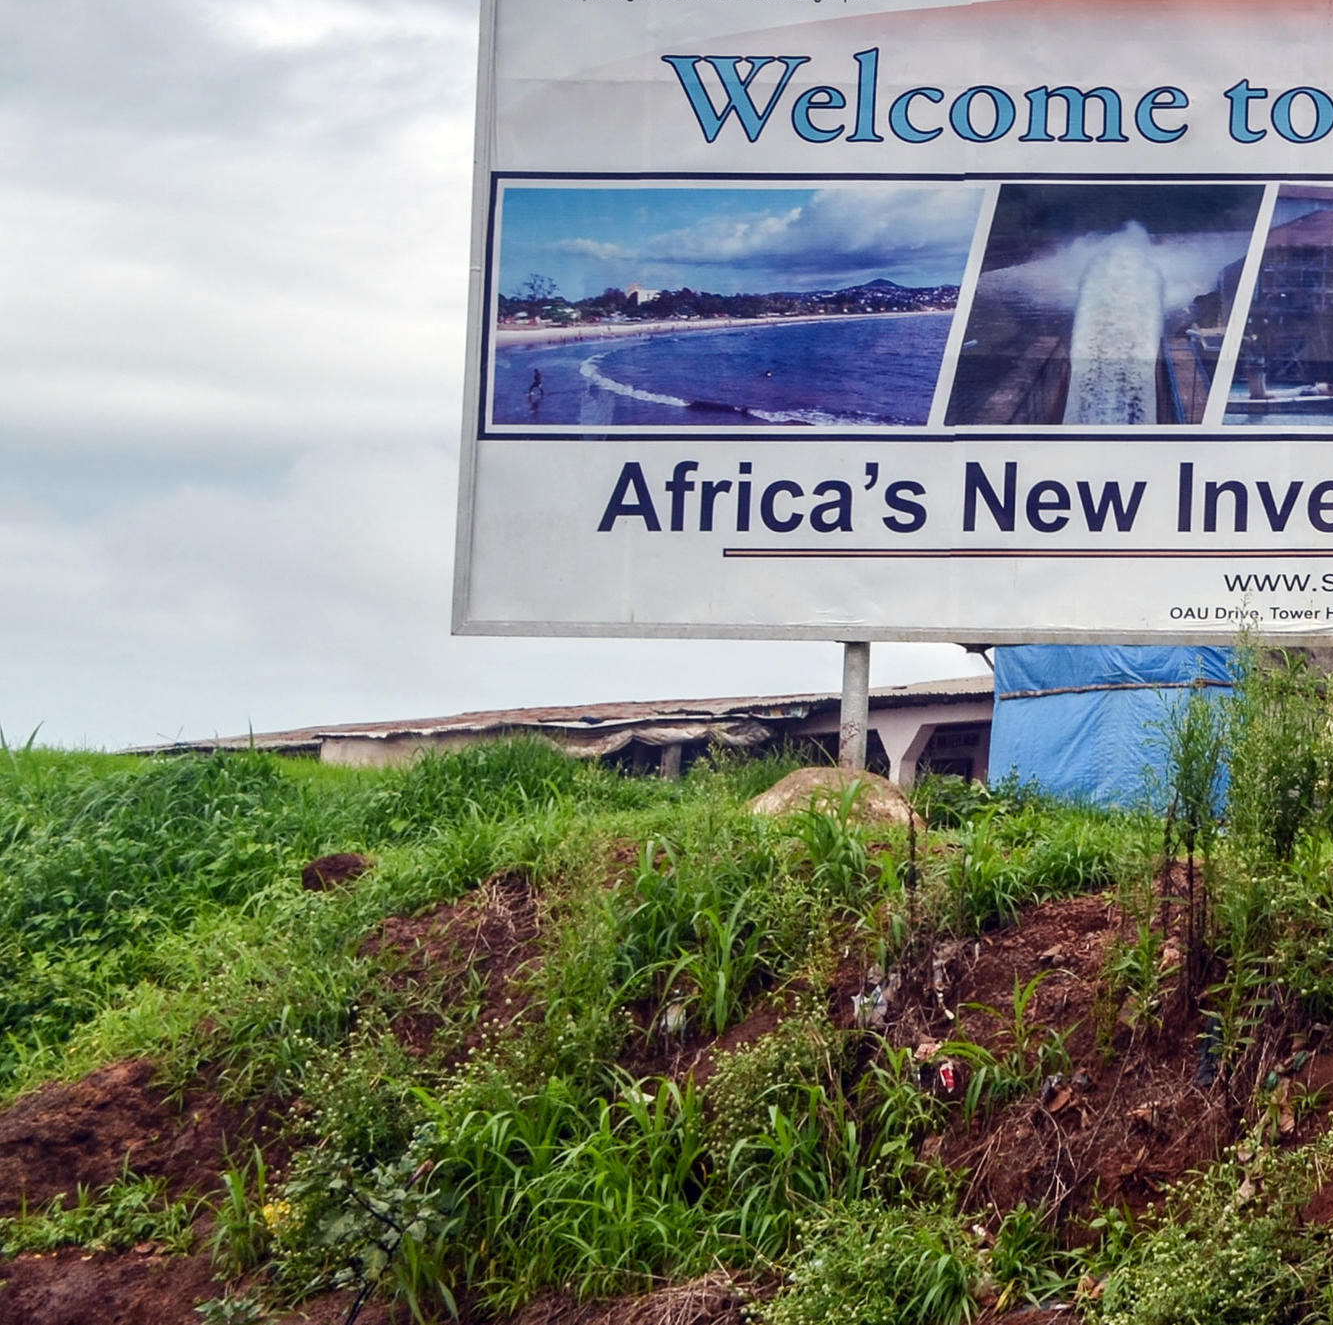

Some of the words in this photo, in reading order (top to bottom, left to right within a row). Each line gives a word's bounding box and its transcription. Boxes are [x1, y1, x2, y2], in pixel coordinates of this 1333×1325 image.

[661, 47, 1190, 144] Welcome
[596, 460, 928, 534] Africa's
[962, 461, 1148, 533] New
[1170, 607, 1209, 620] OAU
[1215, 606, 1263, 622] Drive,
[1270, 607, 1321, 620] Tower
